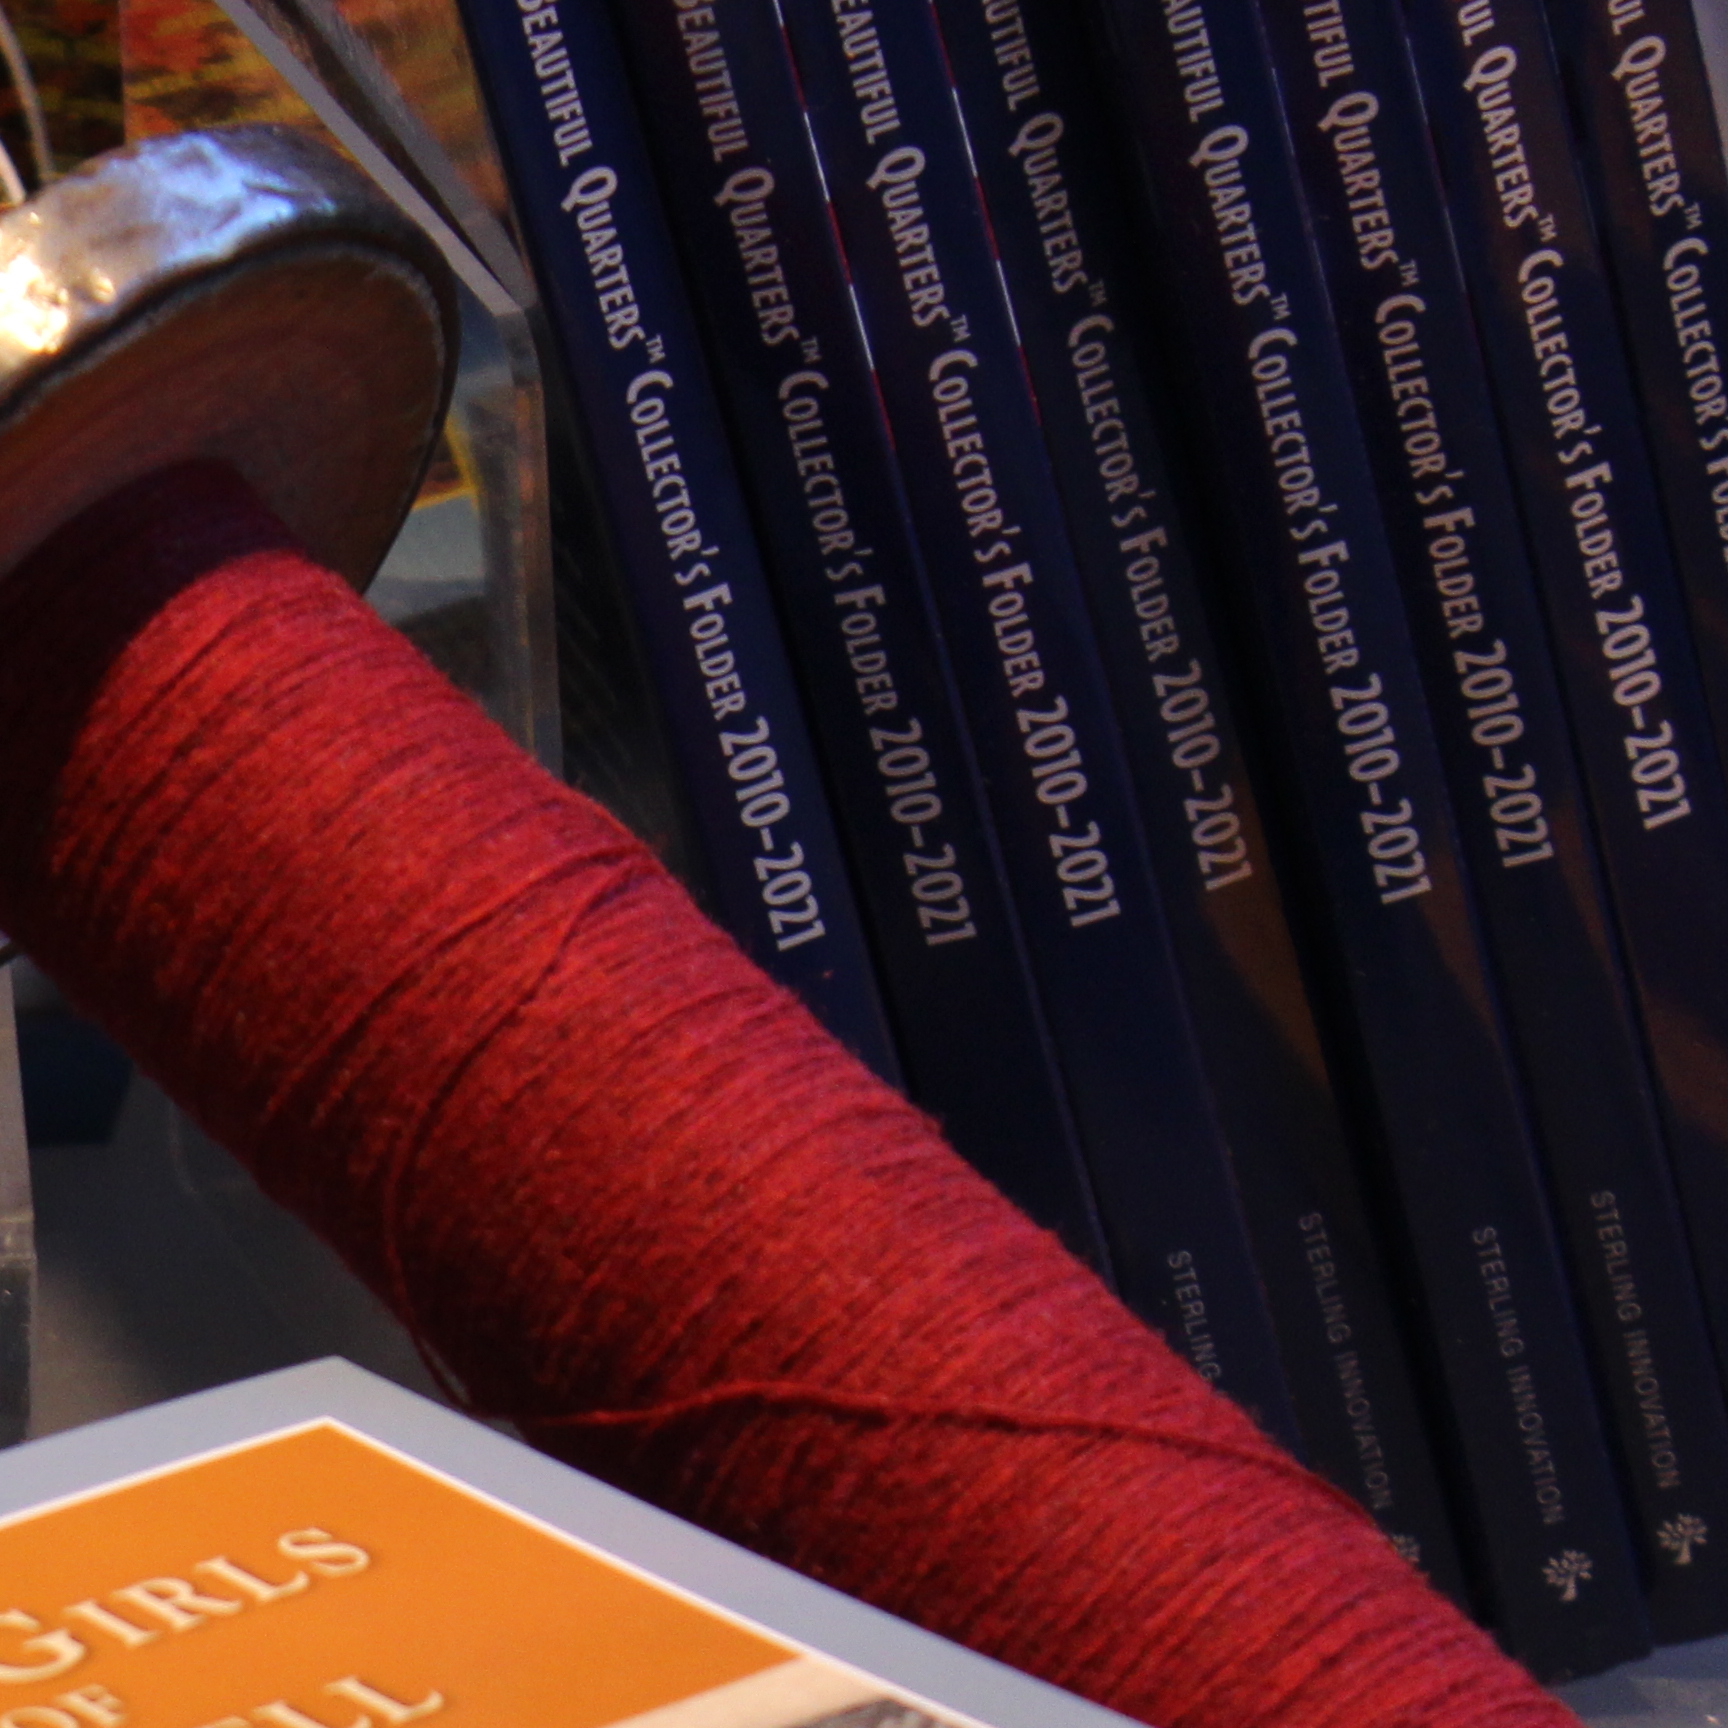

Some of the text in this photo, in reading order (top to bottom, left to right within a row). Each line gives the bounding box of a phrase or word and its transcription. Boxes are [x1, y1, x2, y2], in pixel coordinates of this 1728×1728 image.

[1376, 293, 1472, 506] COLLECTOR'S
[1518, 246, 1602, 469] COLLECTOR'S
[1565, 459, 1623, 602] FOLDER
[1594, 596, 1692, 830] 2010-2021
[626, 369, 723, 588] COLLECTOR'S
[682, 582, 747, 720] FOLDER
[719, 717, 825, 952] 2010-2021
[778, 371, 876, 582] COLLECTOR'S
[834, 584, 899, 717] FOLDER
[868, 716, 977, 946] 2010-2021
[928, 347, 1022, 564] COLLECTOR'S
[981, 562, 1046, 699] FOLDER
[1016, 695, 1121, 928] 2010-2021
[1067, 314, 1155, 531] COLLECTOR'S
[1119, 525, 1178, 664] FOLDER
[1153, 660, 1253, 893] 2010-2021
[1247, 327, 1338, 543] COLLECTOR'S
[1296, 539, 1362, 677] FOLDER
[1330, 673, 1432, 905] 2010-2021
[1423, 504, 1485, 641] FOLDER
[1454, 638, 1553, 870] 2010-2021
[1168, 1250, 1222, 1380] STERLING
[1300, 1212, 1391, 1510] STERLING INNOVATION
[1473, 1226, 1563, 1526] STERLING INNOVATION
[1592, 1190, 1681, 1489] STERLING INNOVATION
